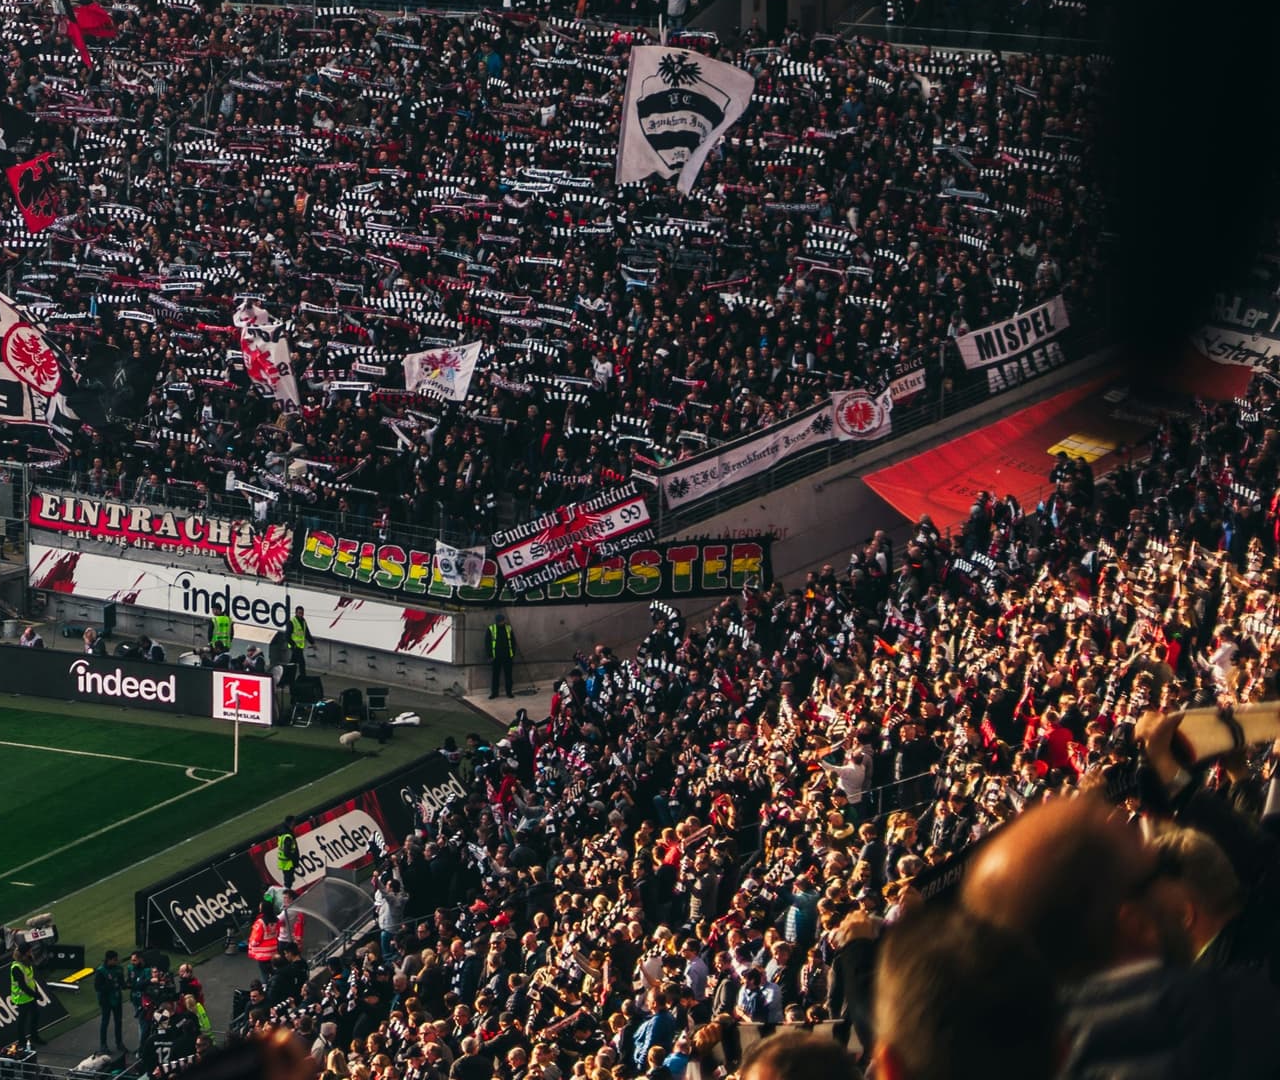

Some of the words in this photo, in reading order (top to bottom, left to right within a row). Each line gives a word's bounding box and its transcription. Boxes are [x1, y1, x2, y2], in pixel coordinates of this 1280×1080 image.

[973, 307, 1057, 362] MISPEL
[987, 341, 1067, 394] ADLER
[40, 492, 256, 548] EINTRACHT
[491, 512, 560, 548] Eintracht
[563, 482, 638, 524] Frankfurt
[504, 550, 524, 571] 18
[619, 504, 643, 525] 99
[722, 525, 763, 541] Arena
[768, 524, 790, 540] Tor
[68, 529, 90, 541] auf
[97, 533, 127, 548] ewig
[133, 536, 154, 551] dir
[161, 542, 217, 558] ergeben
[596, 527, 656, 559] Hessen
[182, 578, 291, 629] indeed
[76, 664, 177, 705] indeed
[223, 711, 261, 721] BUNESLIGA
